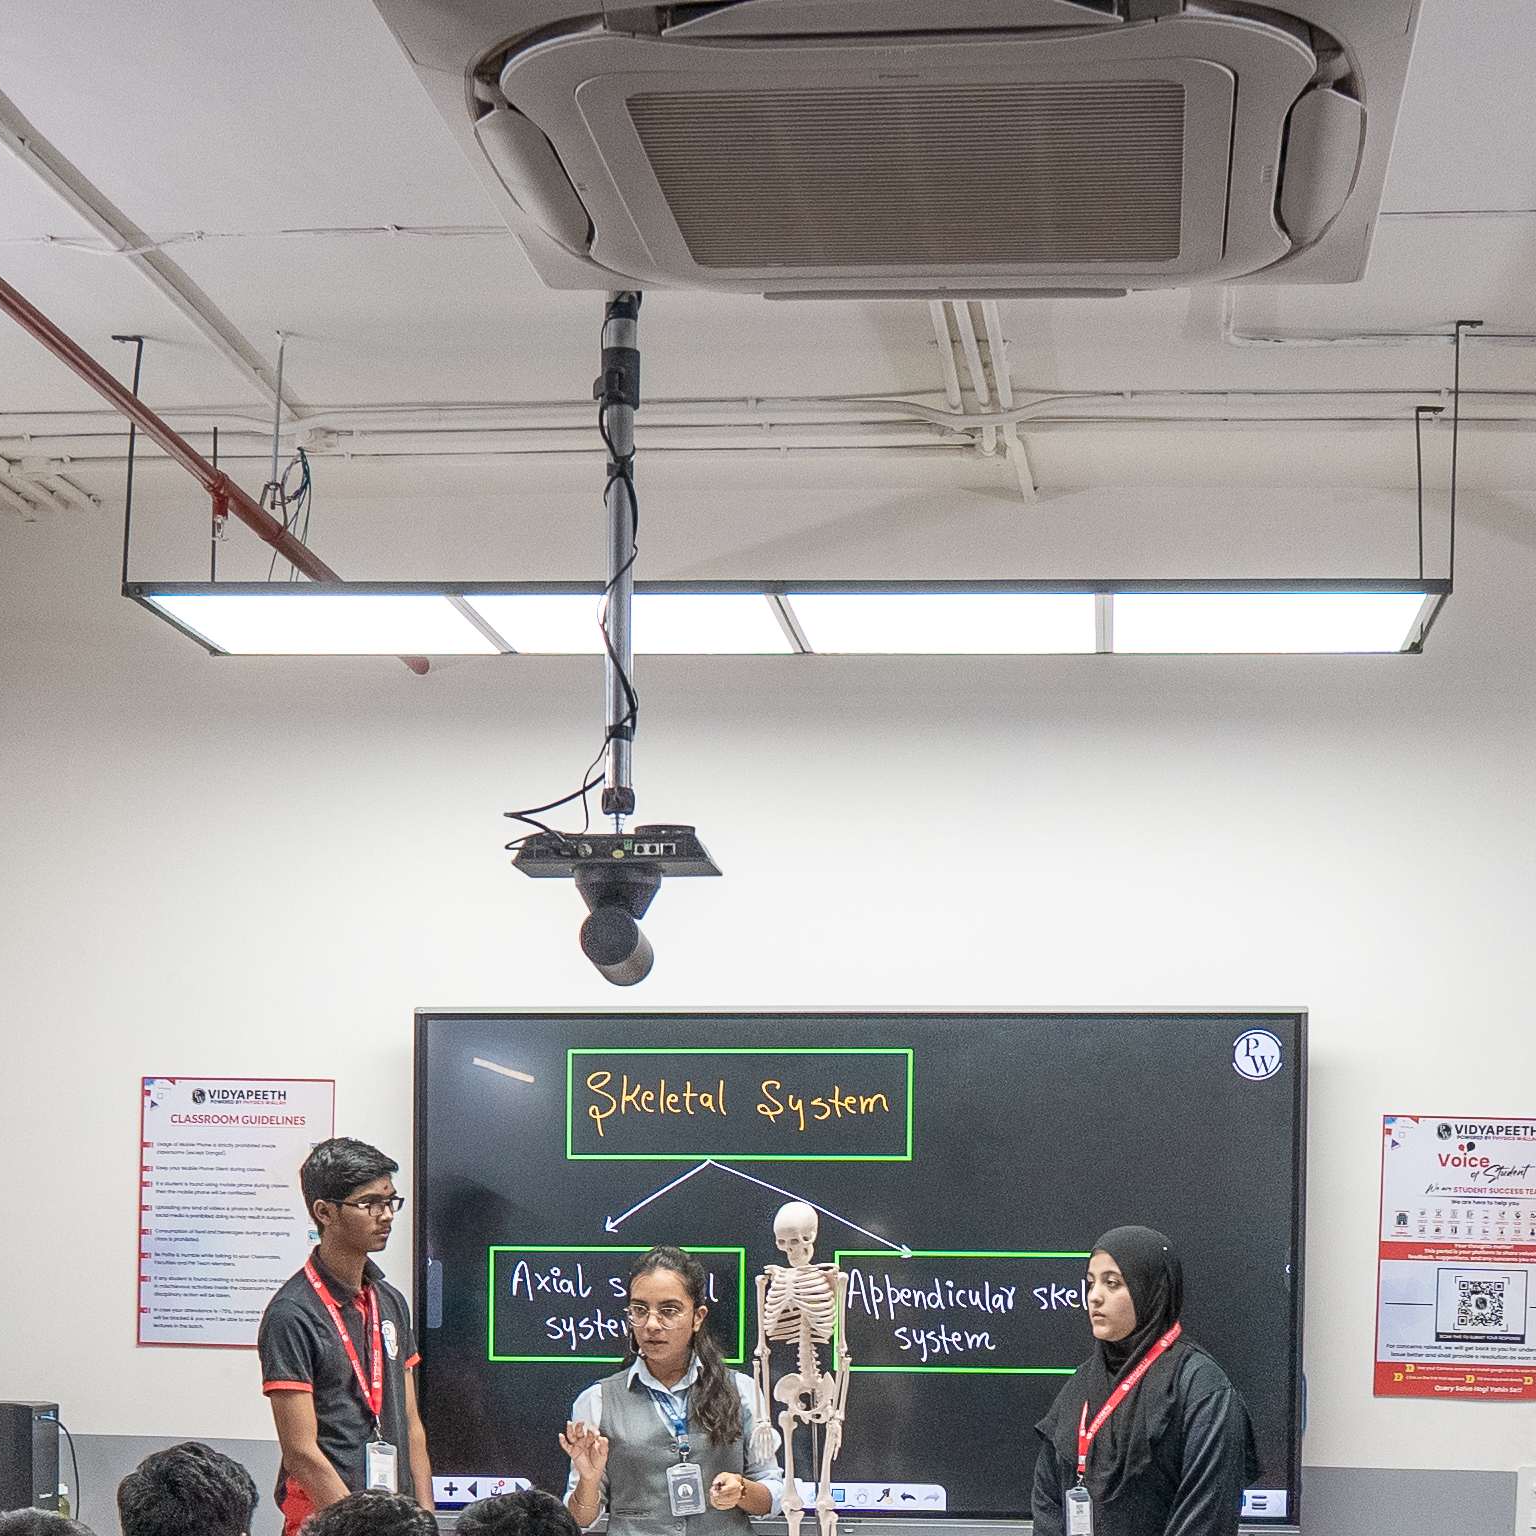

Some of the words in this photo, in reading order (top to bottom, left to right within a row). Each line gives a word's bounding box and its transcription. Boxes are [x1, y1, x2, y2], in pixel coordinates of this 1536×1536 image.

[208, 1089, 287, 1100] VIDYAPEETH
[586, 1071, 727, 1137] Skeletal
[757, 1081, 889, 1131] System
[171, 1114, 239, 1124] CLASSROOM
[242, 1115, 306, 1126] GUIDELINES
[1438, 1153, 1489, 1168] Voice
[512, 1260, 592, 1301] Axial
[848, 1268, 1015, 1320] Appendicular
[1032, 1280, 1088, 1310] skel
[545, 1309, 628, 1350] syste
[894, 1324, 995, 1362] system
